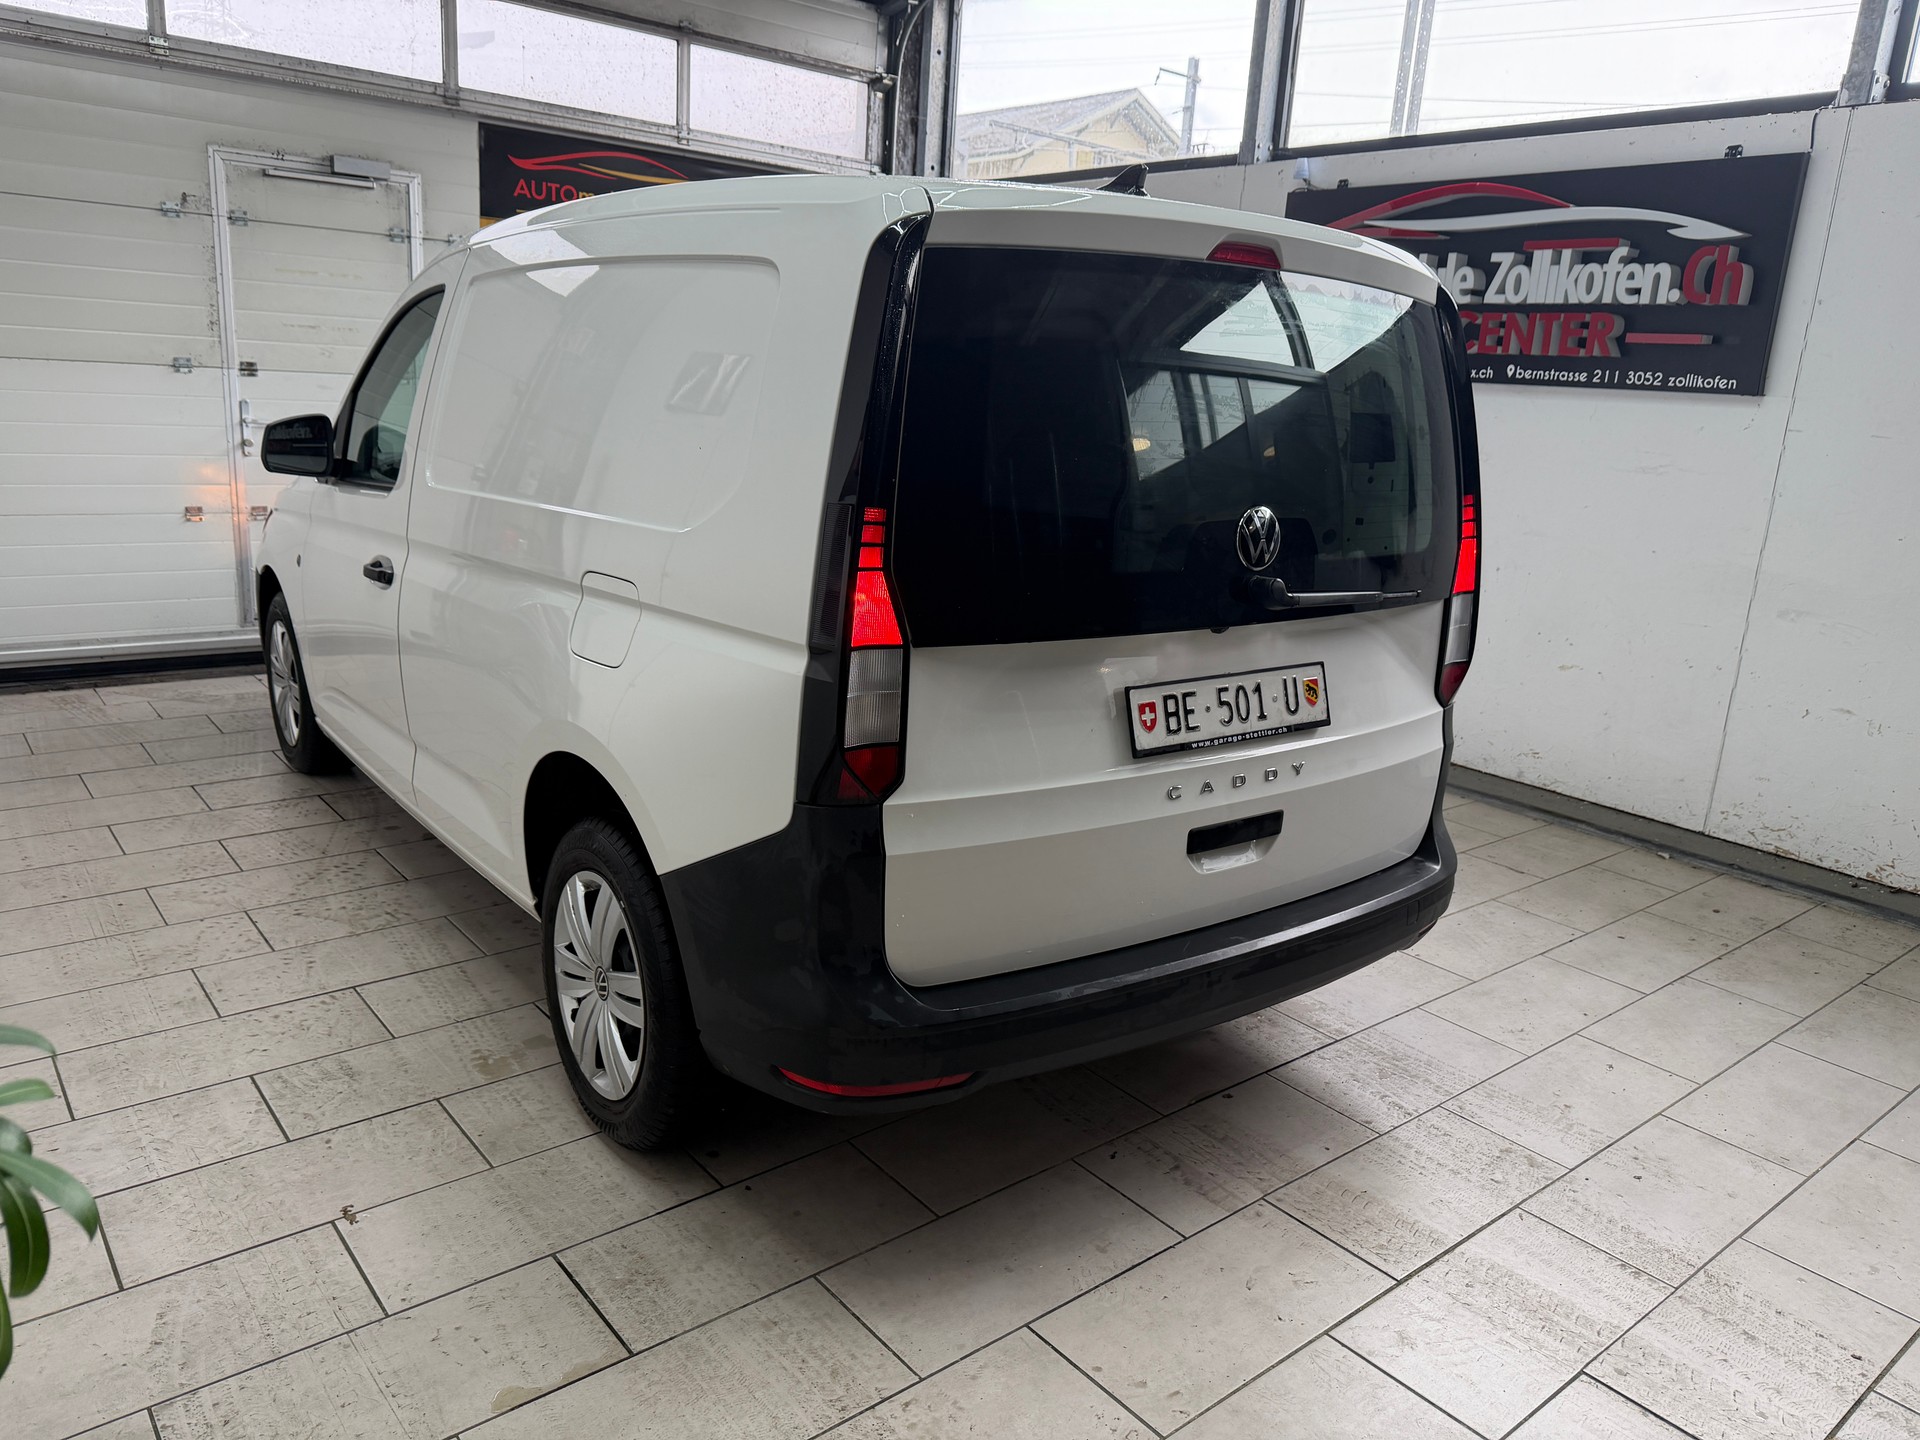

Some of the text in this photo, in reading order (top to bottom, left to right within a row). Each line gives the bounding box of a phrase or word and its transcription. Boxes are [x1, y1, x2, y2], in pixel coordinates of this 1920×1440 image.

[1470, 366, 1738, 390] x.ch bernstrasse 211 3052 zollikofen
[1166, 760, 1305, 801] CADDY
